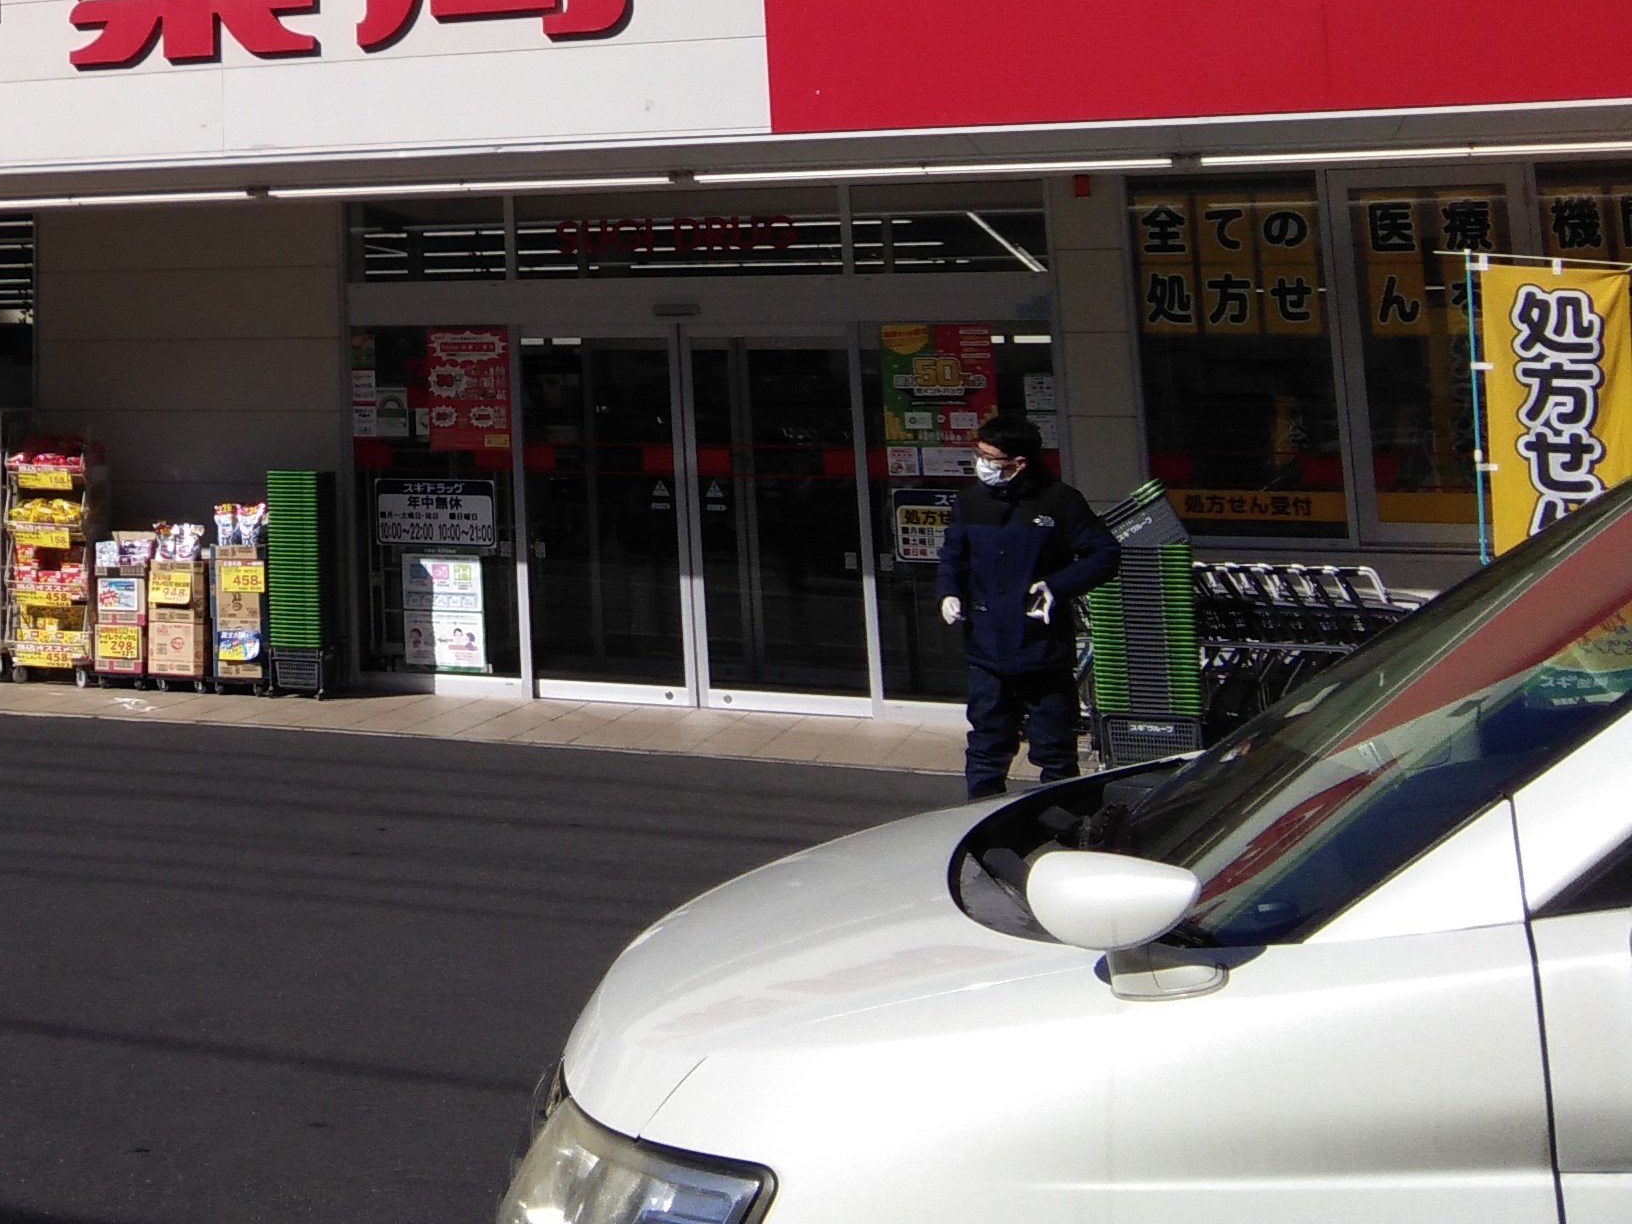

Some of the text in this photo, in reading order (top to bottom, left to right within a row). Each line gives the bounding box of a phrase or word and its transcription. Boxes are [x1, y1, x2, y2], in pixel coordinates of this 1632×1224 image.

[556, 215, 798, 254] SUGI DRUG
[402, 482, 465, 494] スギドラッグ
[407, 496, 462, 509] 年中無休
[1184, 493, 1313, 517] 処方せん受付
[232, 575, 259, 586] 458
[45, 592, 68, 602] 458
[110, 641, 133, 651] 298
[45, 652, 68, 662] 458
